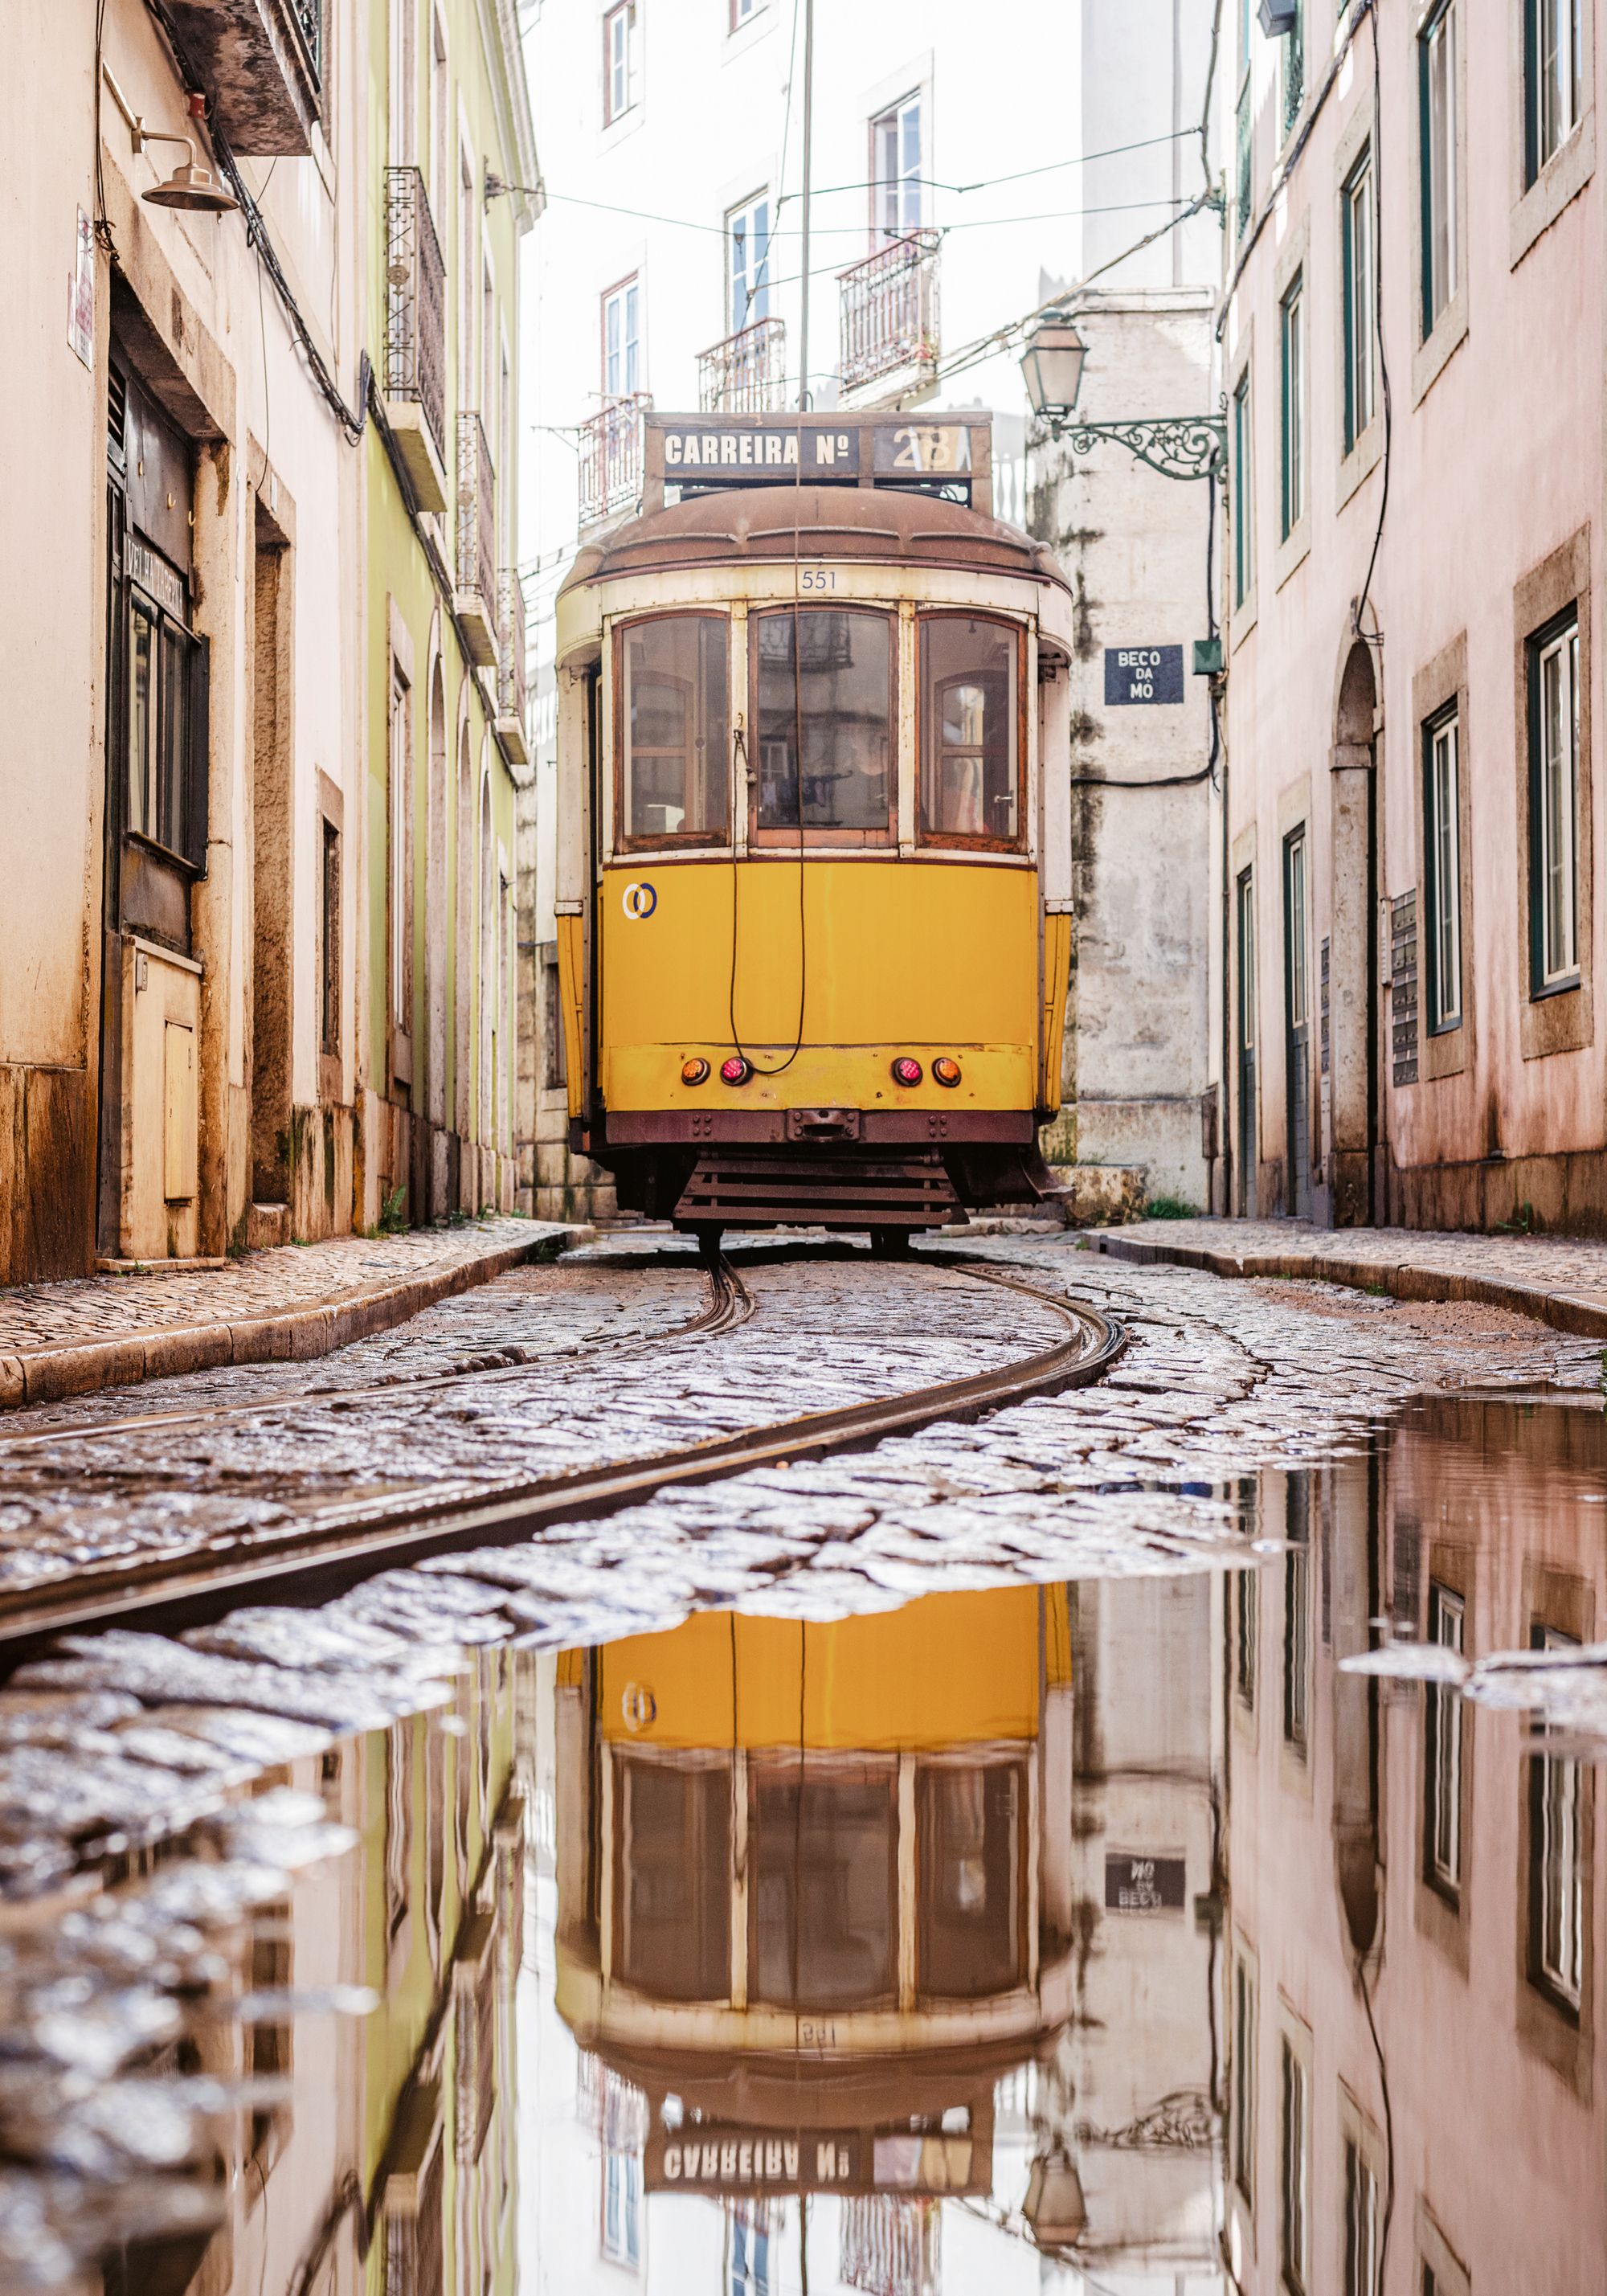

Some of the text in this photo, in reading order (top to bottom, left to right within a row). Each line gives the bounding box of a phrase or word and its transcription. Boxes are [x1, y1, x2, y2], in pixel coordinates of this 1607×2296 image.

[665, 434, 798, 465] CARREIRA
[128, 538, 153, 596] VELHA
[802, 571, 836, 589] 551
[1118, 650, 1161, 667] BECO
[1135, 667, 1154, 680] DA
